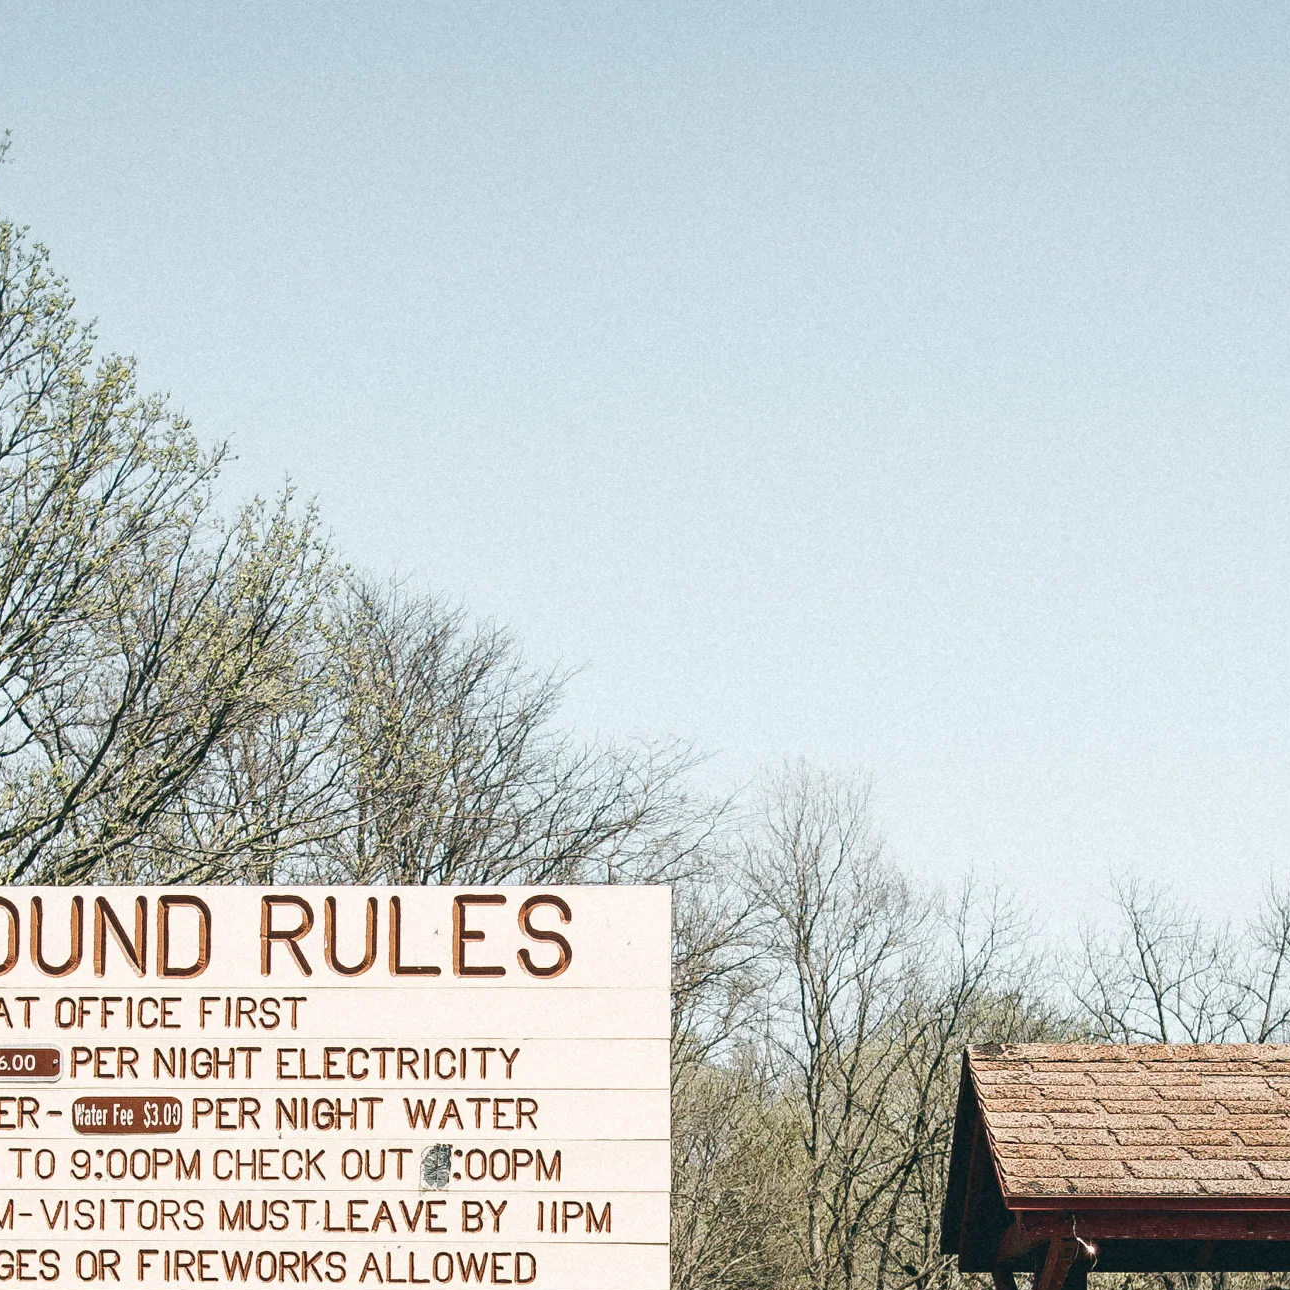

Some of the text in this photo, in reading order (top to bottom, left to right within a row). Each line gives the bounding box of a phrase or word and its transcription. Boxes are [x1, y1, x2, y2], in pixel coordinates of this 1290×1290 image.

[259, 893, 573, 978] RULES
[54, 996, 183, 1029] OFFICE
[199, 996, 308, 1031] FIRST
[70, 1046, 140, 1080] PER
[153, 1046, 262, 1080] NIGHT
[276, 1046, 521, 1080] ELECTRICITY
[74, 1103, 108, 1126] Water
[113, 1103, 134, 1126] Fee
[143, 1101, 181, 1128] $3.00
[191, 1096, 262, 1130] PER
[275, 1096, 384, 1131] NIGHT
[402, 1097, 539, 1131] WATER
[7, 1147, 56, 1180] TO
[70, 1147, 201, 1181] 9:00PM
[212, 1148, 326, 1181] CHECK
[341, 1147, 414, 1181] OUT
[427, 1148, 562, 1182] :00PM
[219, 1199, 317, 1232] MUST
[322, 1199, 448, 1233] LEAVE
[461, 1199, 508, 1234] BY
[537, 1200, 612, 1234] 11PM
[75, 1248, 121, 1282] OR
[137, 1248, 347, 1283] FIREWORKS
[358, 1251, 537, 1284] ALLOWED
